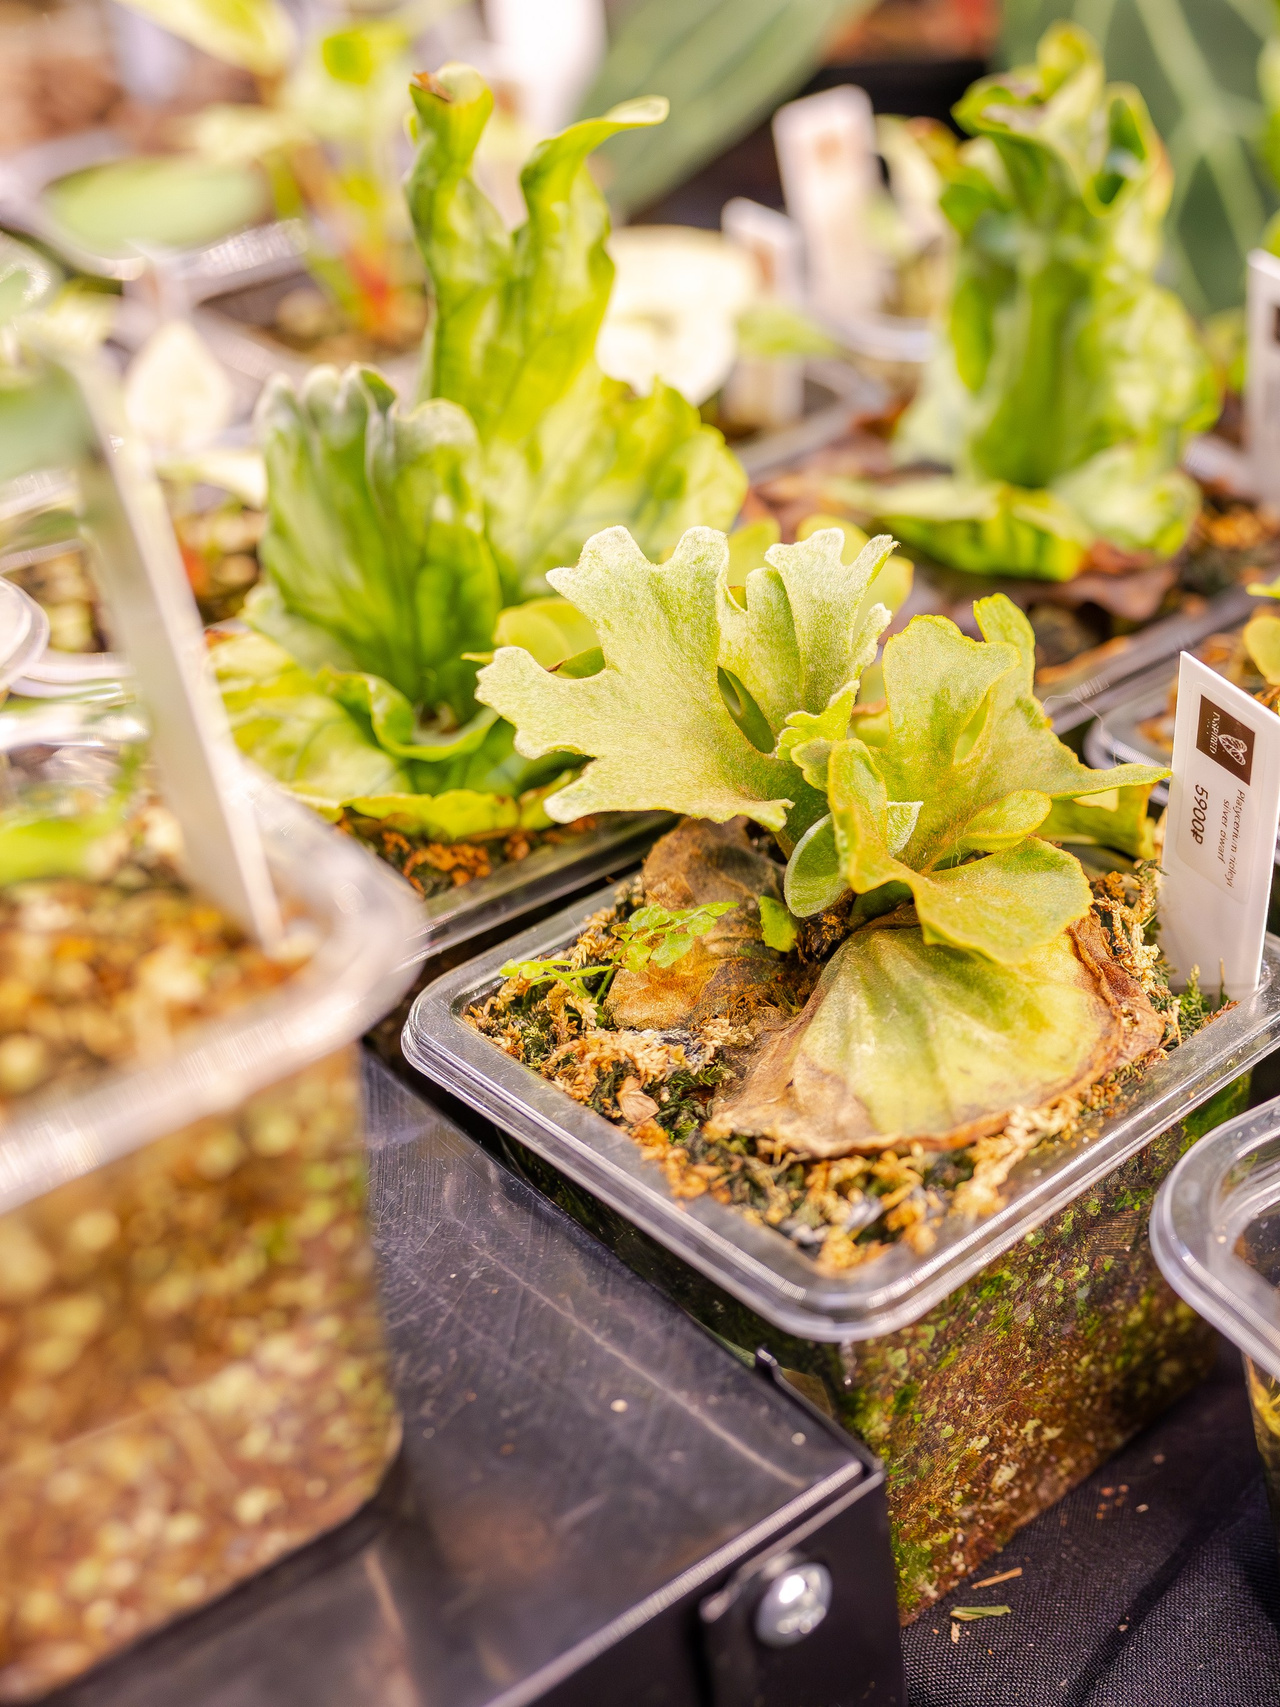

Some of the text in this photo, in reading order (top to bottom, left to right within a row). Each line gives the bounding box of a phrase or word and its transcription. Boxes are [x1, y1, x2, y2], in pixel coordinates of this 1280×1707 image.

[1209, 711, 1221, 755] INSPIRED
[1217, 799, 1232, 864] silver dwarf
[1224, 789, 1245, 888] Platycerium ridleyi
